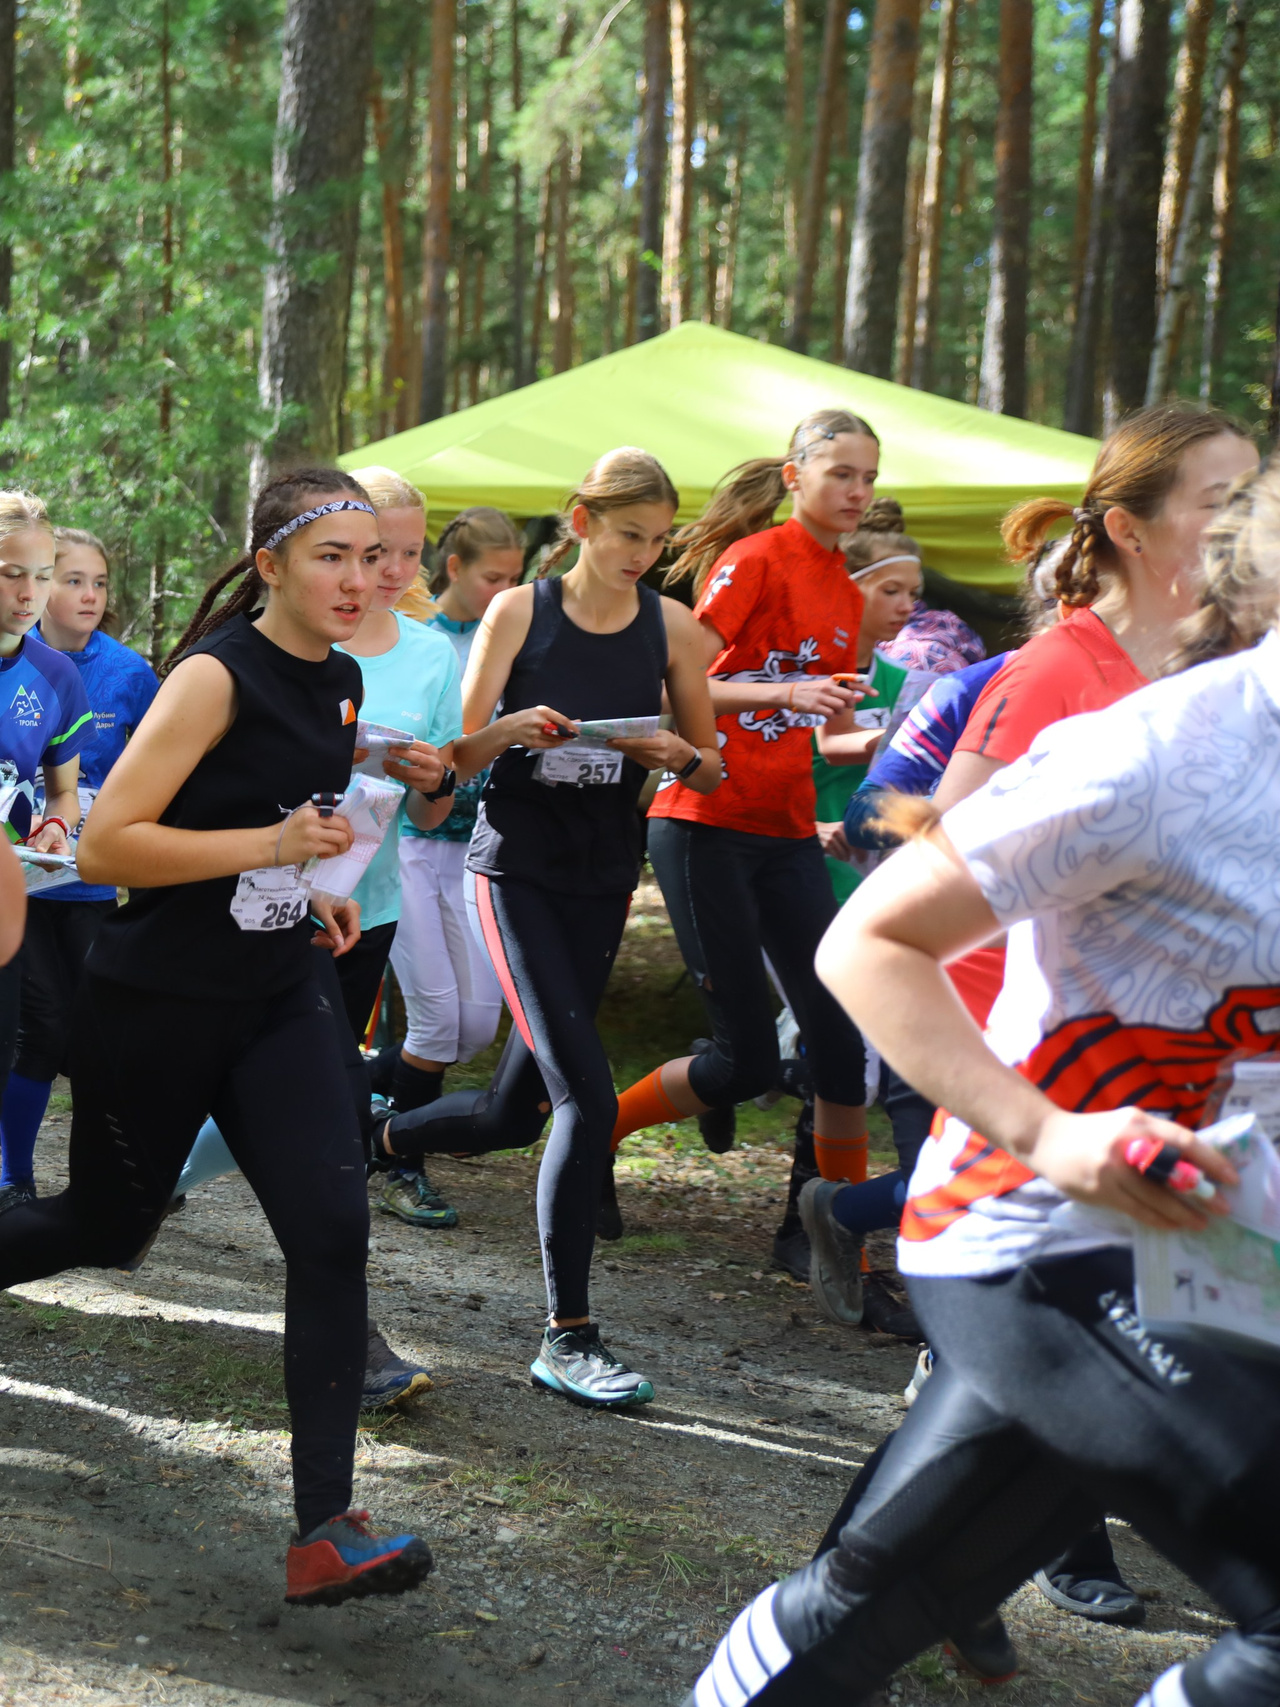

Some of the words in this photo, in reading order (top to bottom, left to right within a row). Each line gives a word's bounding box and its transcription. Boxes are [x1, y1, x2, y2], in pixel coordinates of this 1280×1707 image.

[19, 719, 38, 727] ТРОПА
[577, 763, 618, 784] 257
[261, 900, 302, 928] 264
